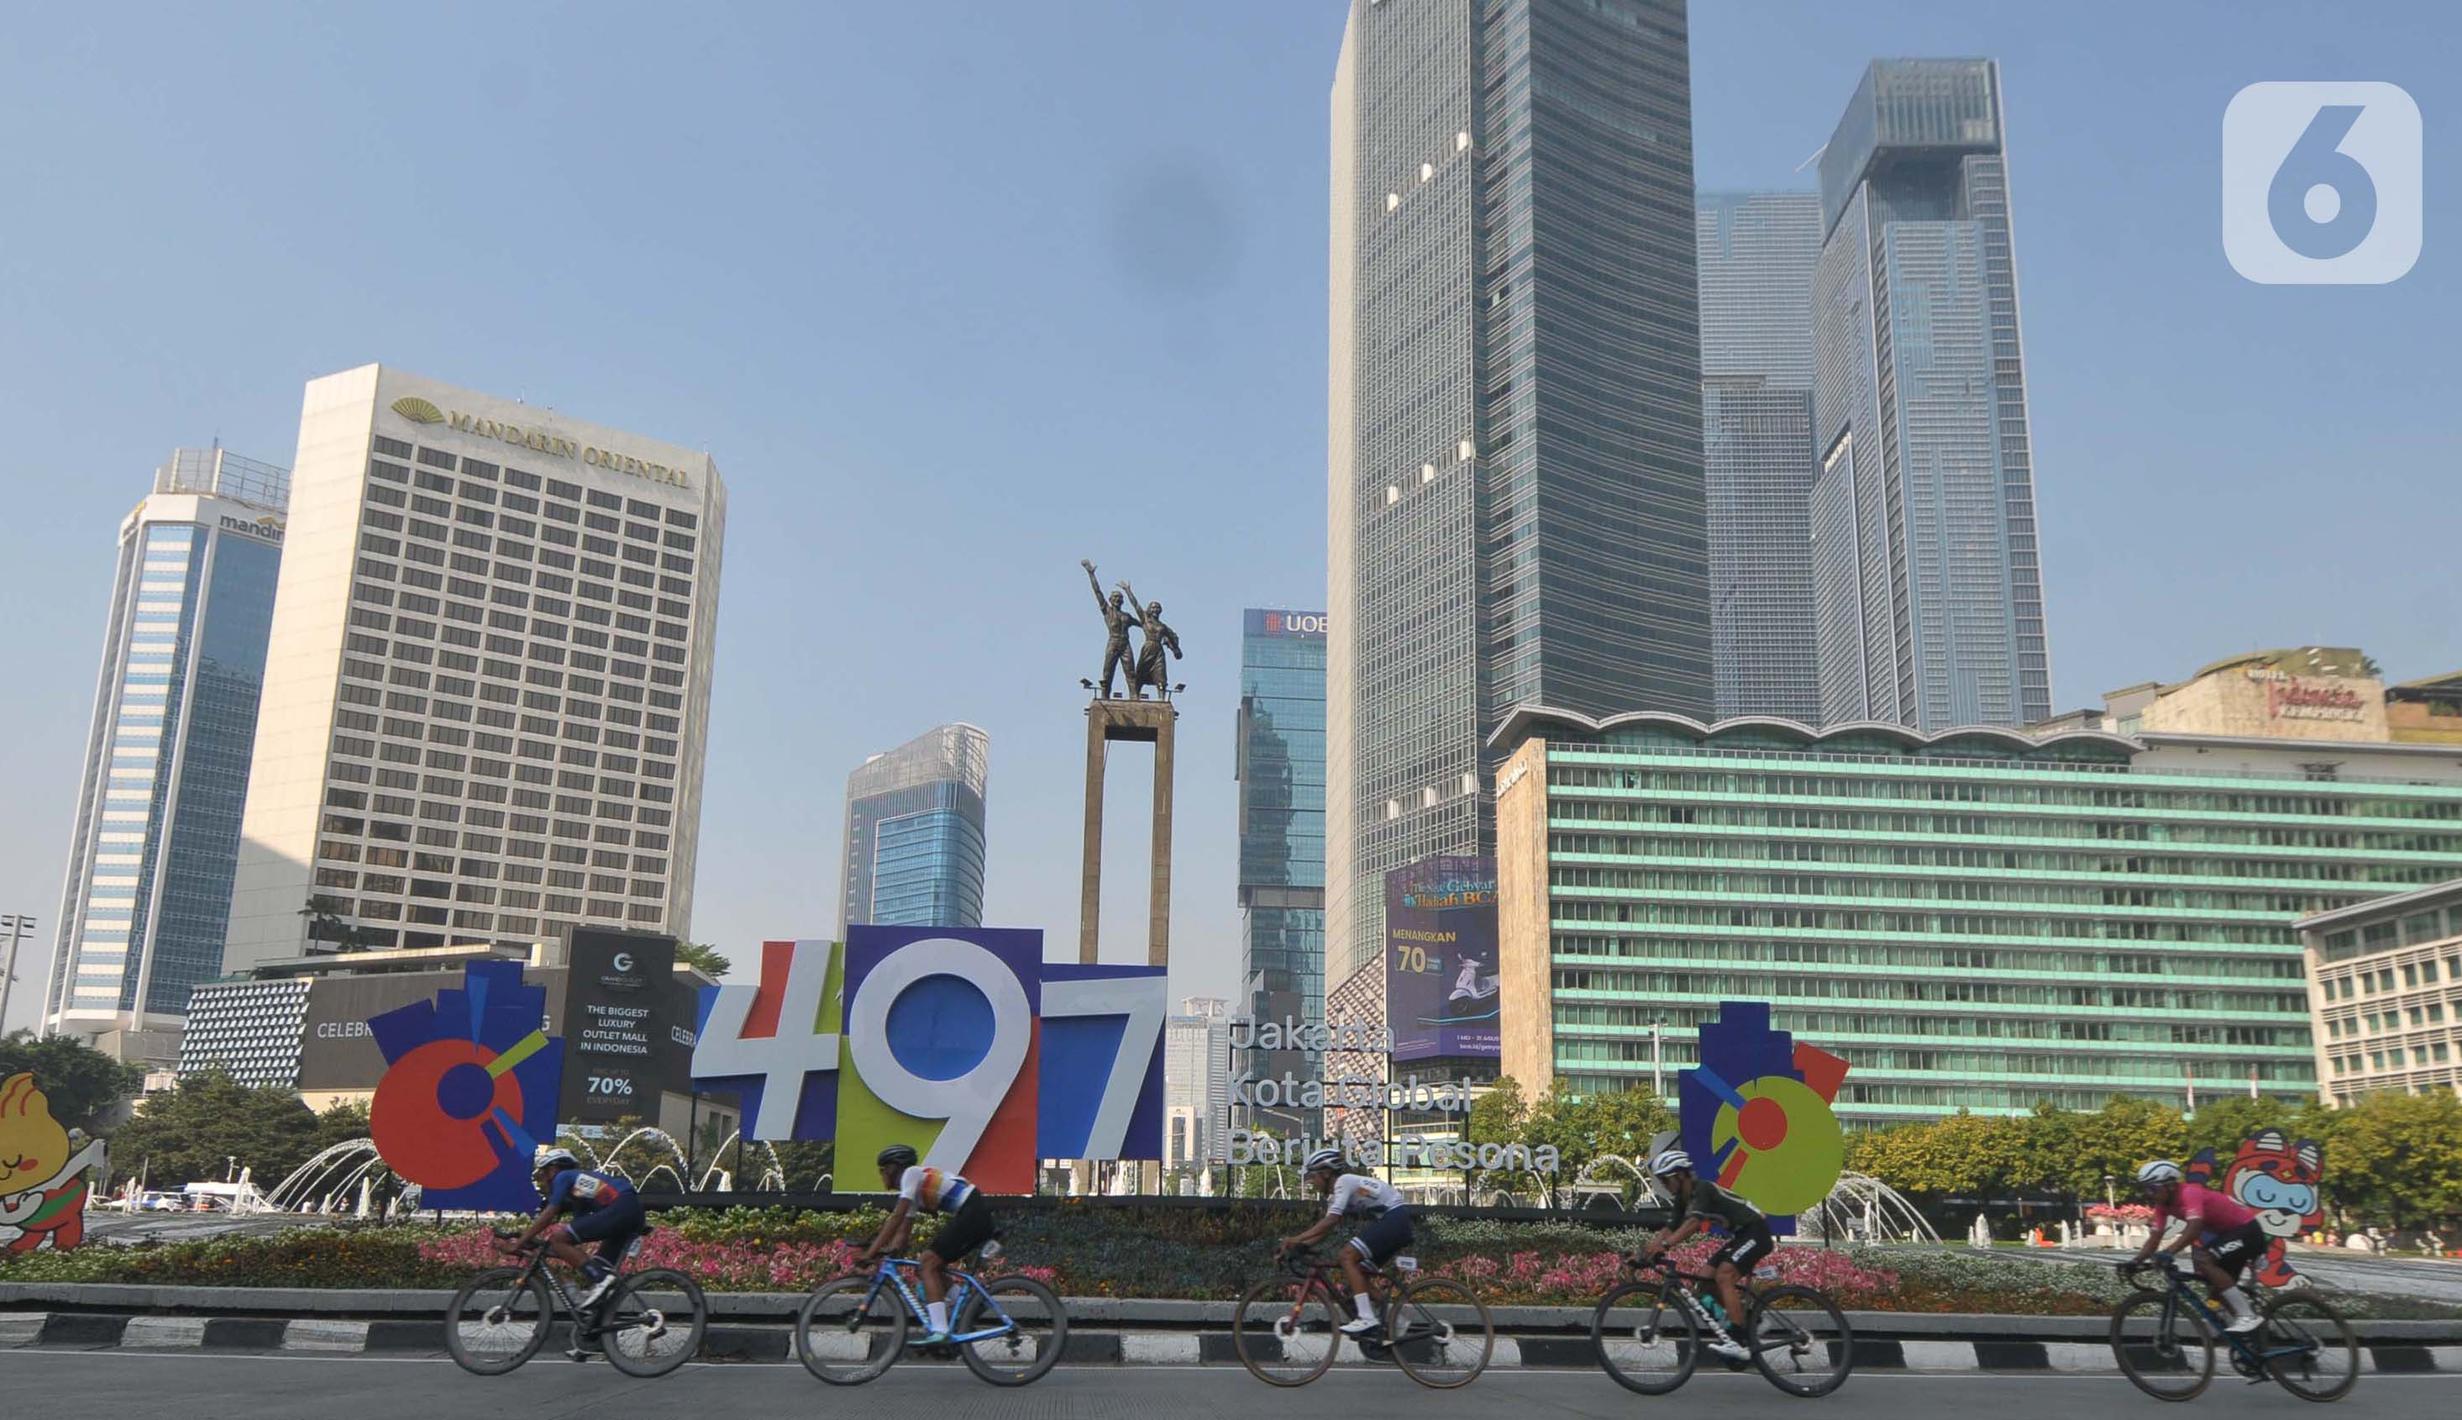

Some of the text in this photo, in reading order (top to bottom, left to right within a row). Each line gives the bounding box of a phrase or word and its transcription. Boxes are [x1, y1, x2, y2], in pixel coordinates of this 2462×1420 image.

[449, 410, 690, 489] MANDARIN ORIENTAL
[1392, 928, 1456, 942] MENANGKAN
[613, 952, 634, 972] G
[1397, 945, 1427, 973] 70
[587, 1004, 649, 1018] THE BIGGEST
[598, 1018, 636, 1029] LUXURY
[1229, 1014, 1395, 1052] Jakarta
[583, 1029, 648, 1042] OUTLET MALL
[580, 1042, 648, 1054] IN INDONESIA
[588, 1076, 633, 1095] 70%
[1228, 1071, 1471, 1112] Kota Global
[1400, 1134, 1559, 1173] Pesona
